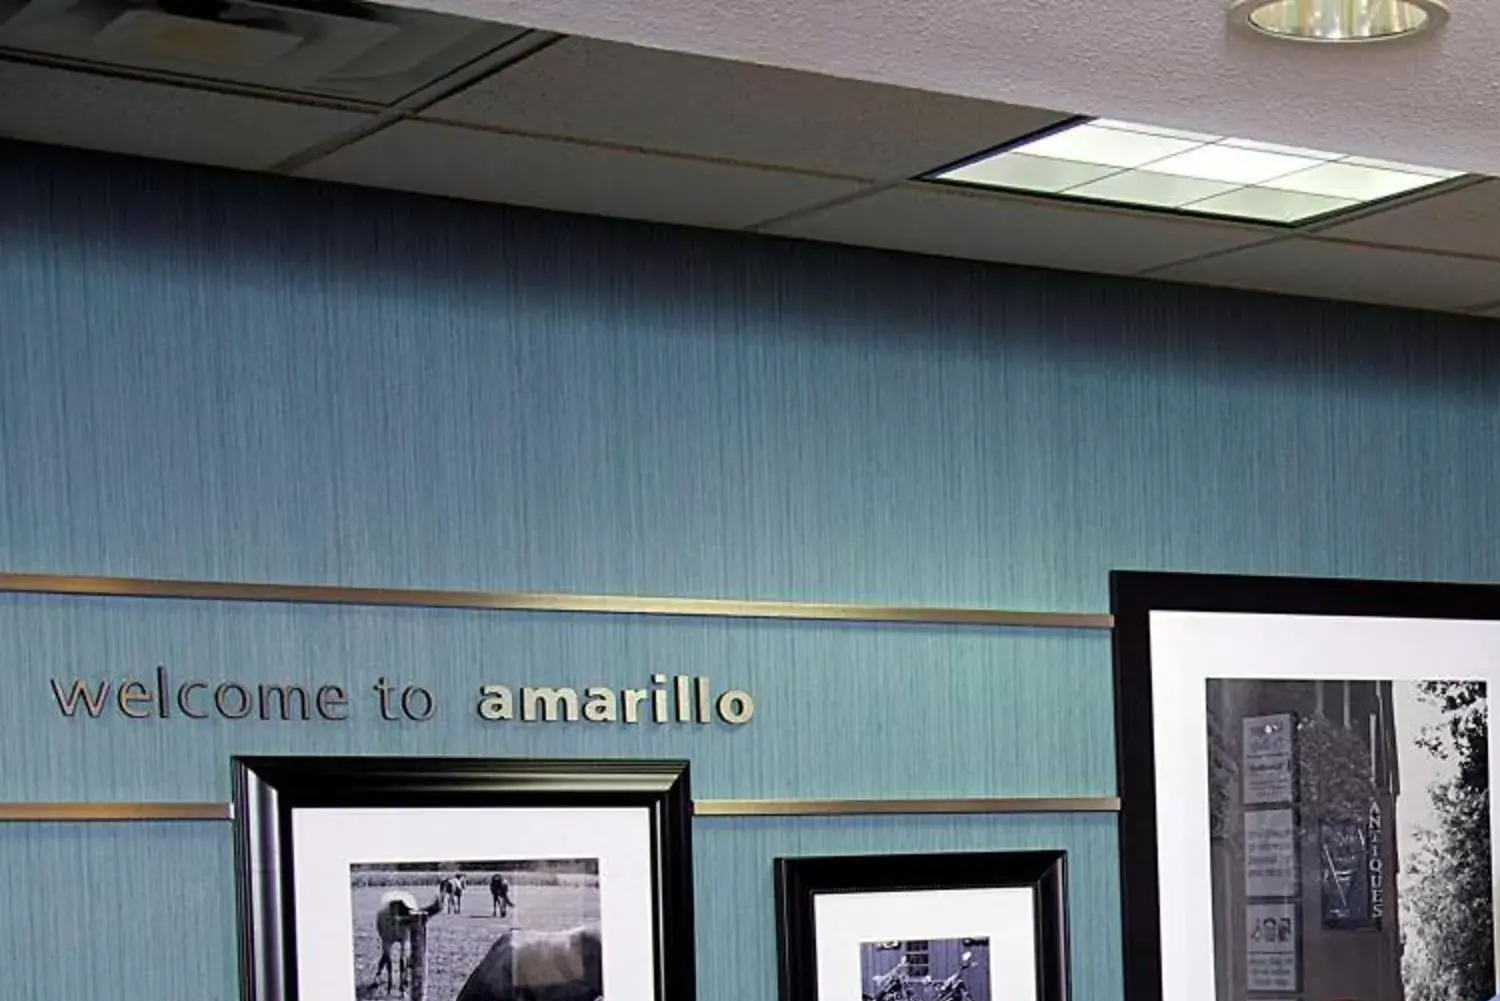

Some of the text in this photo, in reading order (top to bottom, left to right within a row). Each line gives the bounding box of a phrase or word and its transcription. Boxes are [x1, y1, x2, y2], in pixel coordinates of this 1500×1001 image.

[50, 666, 755, 725] welcome to amarillo
